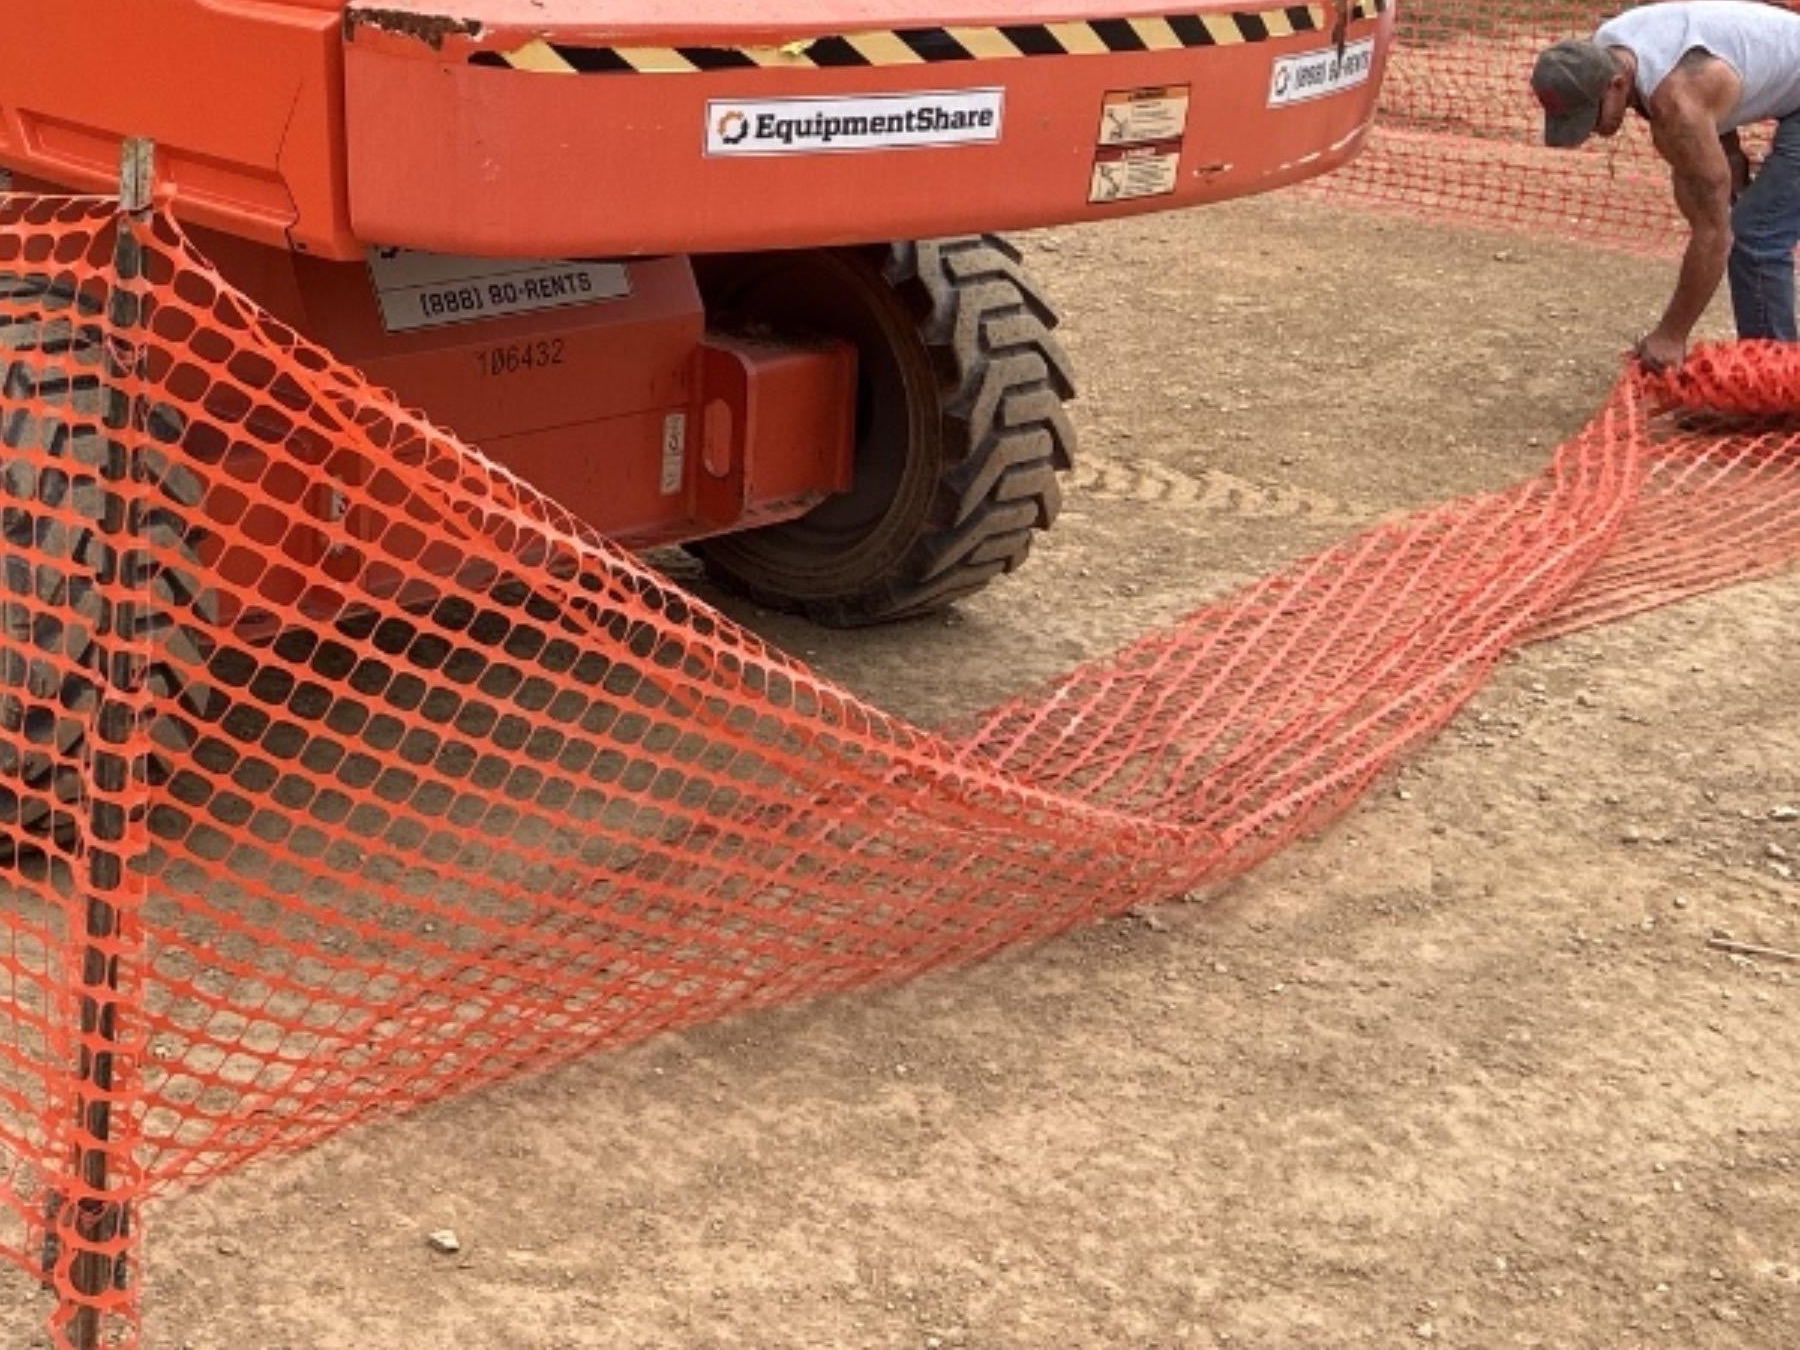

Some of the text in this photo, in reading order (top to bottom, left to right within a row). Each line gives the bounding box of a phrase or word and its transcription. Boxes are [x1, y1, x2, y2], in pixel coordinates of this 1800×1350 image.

[755, 106, 994, 144] EquipmentShare
[419, 271, 593, 318] (888) 80-RENTS
[475, 337, 566, 377] 106432
